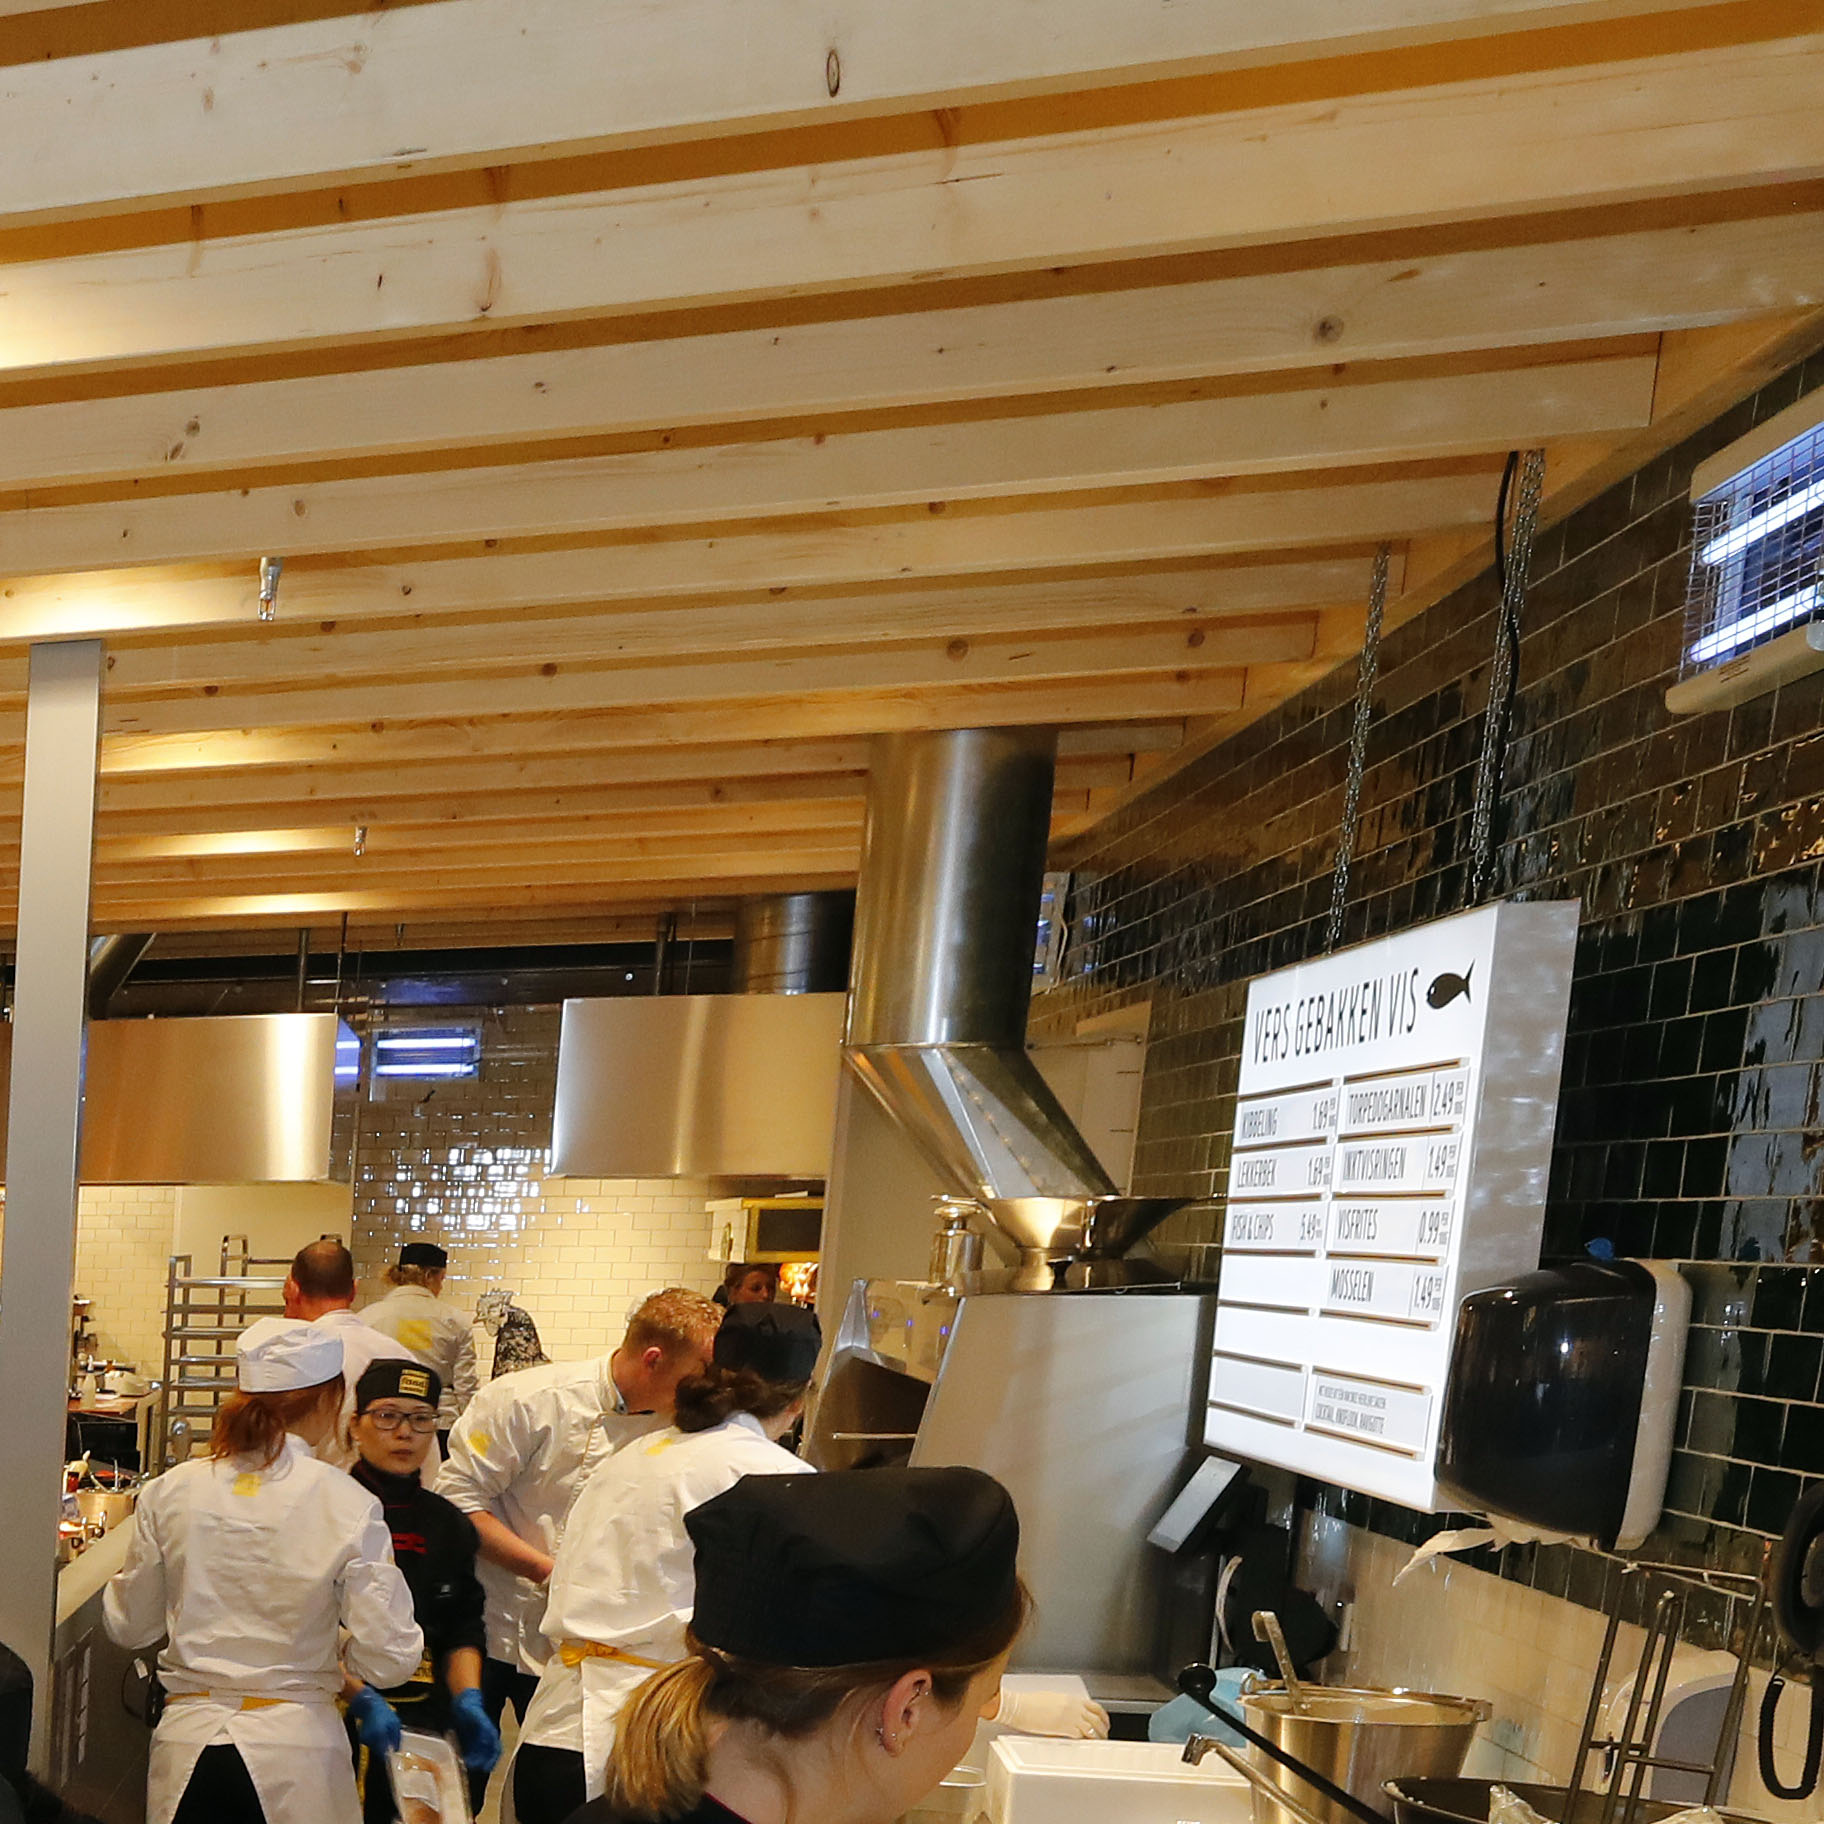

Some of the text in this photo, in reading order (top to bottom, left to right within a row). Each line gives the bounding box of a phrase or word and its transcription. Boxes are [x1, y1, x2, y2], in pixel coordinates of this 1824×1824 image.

[1254, 966, 1419, 1066] VERS GEBAKKEN VIS
[1433, 1081, 1455, 1117] 2.49
